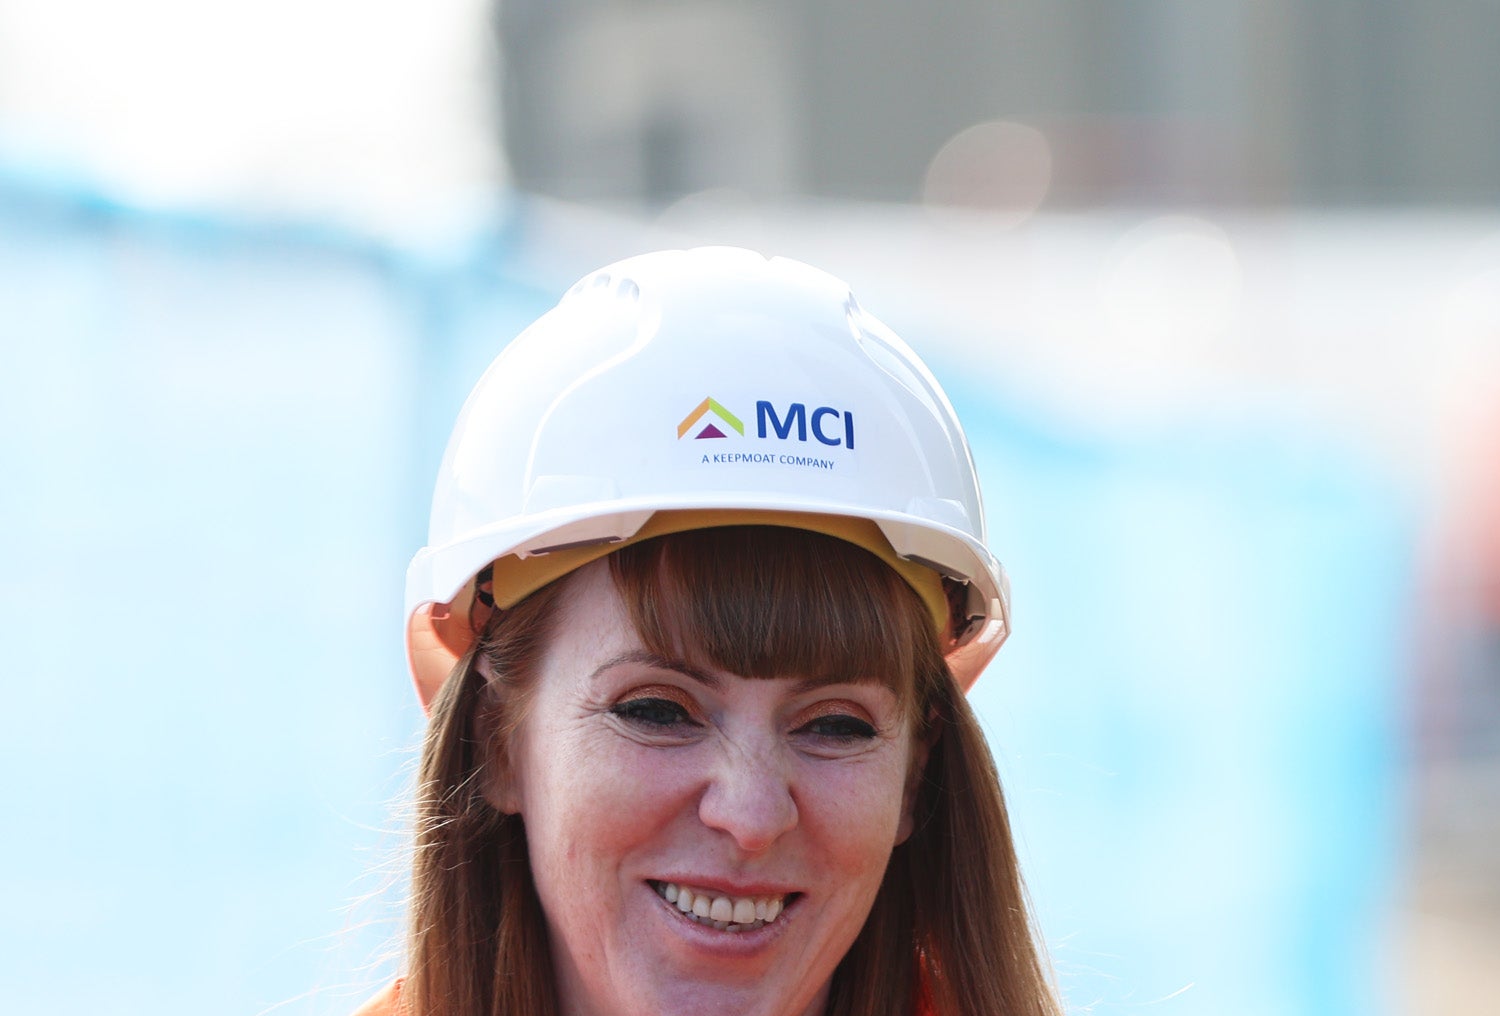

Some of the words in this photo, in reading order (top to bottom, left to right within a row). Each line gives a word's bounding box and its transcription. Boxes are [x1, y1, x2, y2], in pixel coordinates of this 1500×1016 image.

[756, 400, 855, 450] MCI
[701, 454, 710, 464] A
[713, 453, 776, 465] KEEPMOAT
[779, 454, 835, 470] COMPANY
